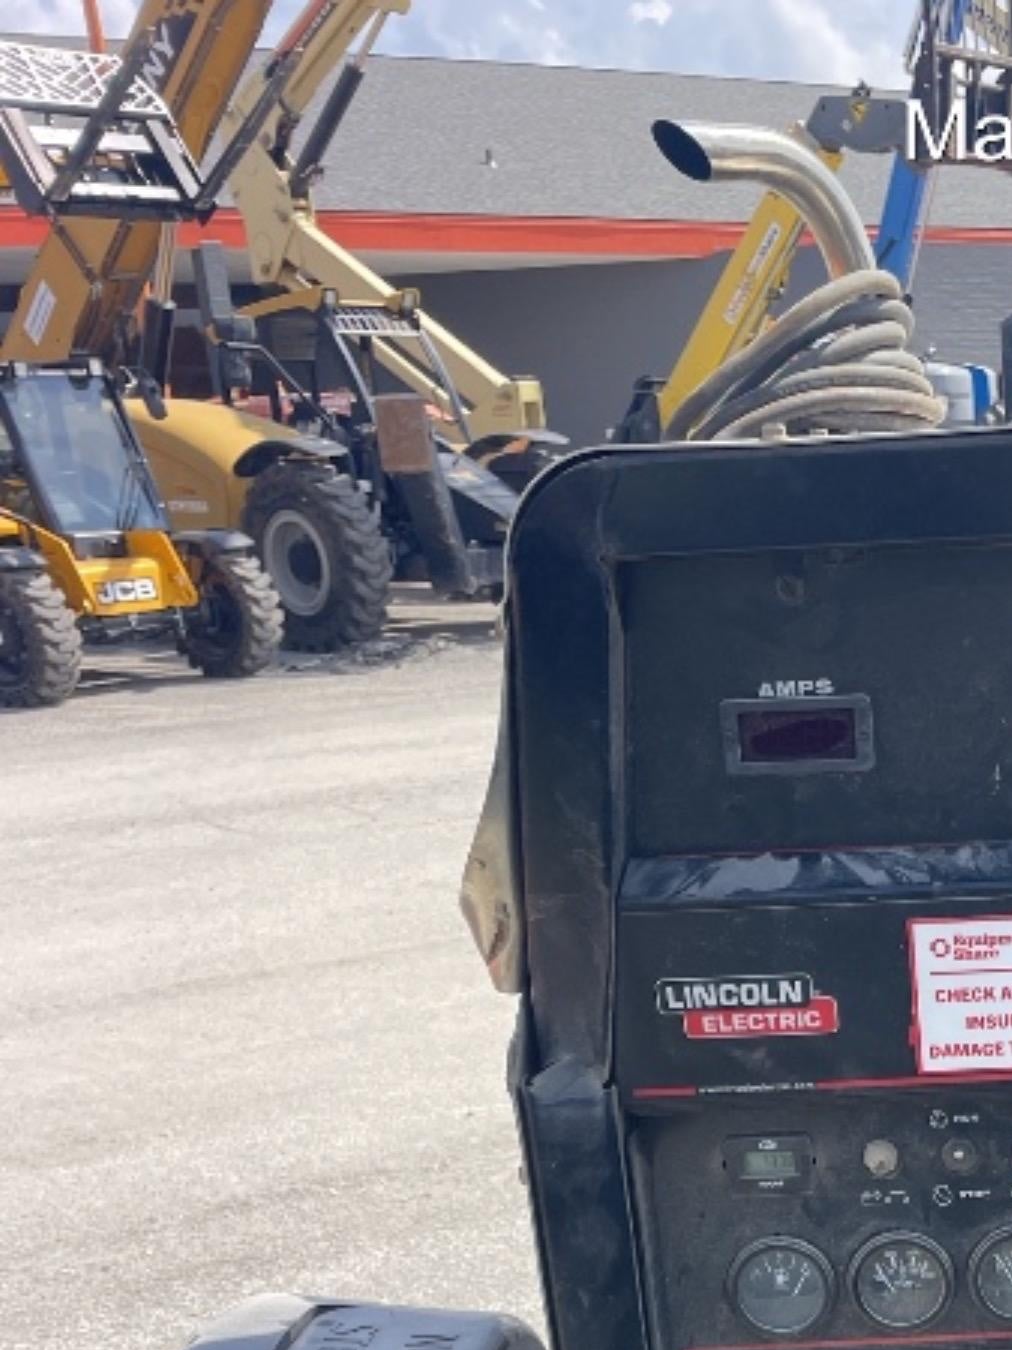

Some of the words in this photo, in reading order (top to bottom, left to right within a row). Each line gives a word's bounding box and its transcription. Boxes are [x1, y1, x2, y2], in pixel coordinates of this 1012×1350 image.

[97, 577, 157, 604] JCB
[758, 678, 834, 697] AMPS
[665, 980, 802, 1010] LINCOLN
[935, 985, 997, 1003] CHECK
[702, 1010, 823, 1033] ELECTRIC
[929, 1041, 1004, 1059] DAMAGE
